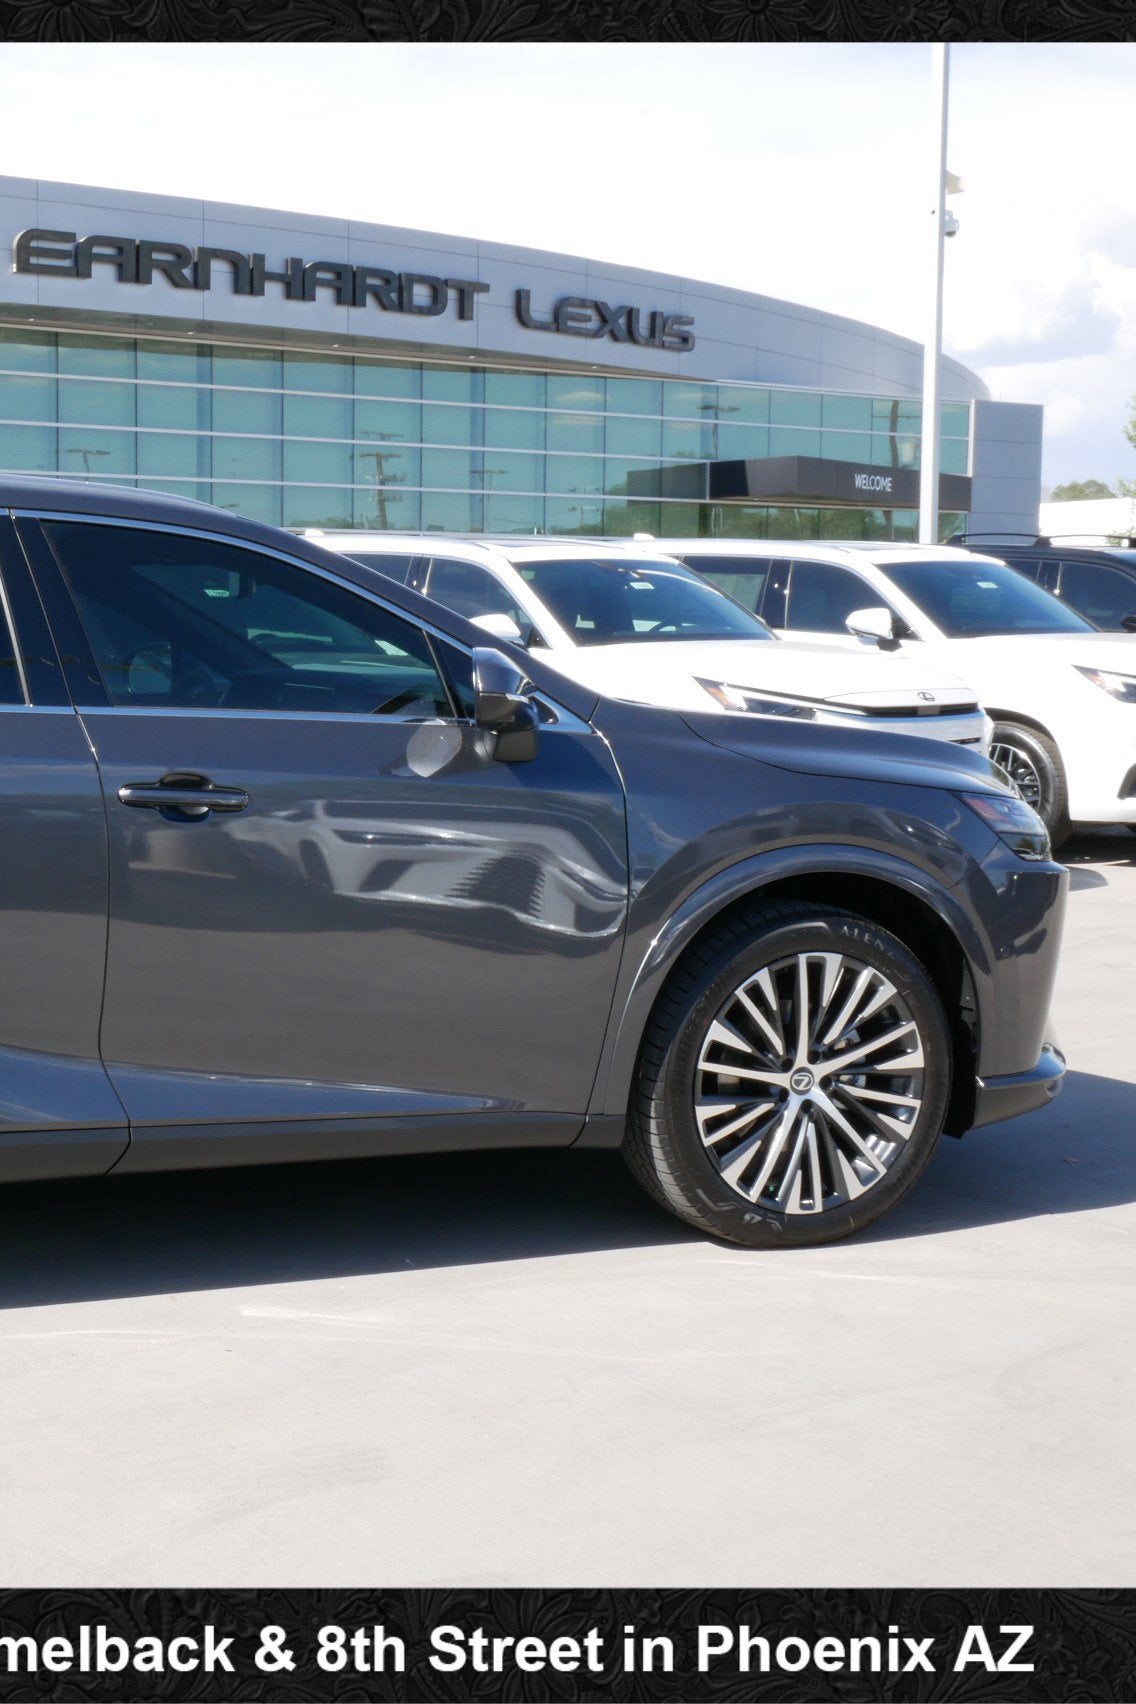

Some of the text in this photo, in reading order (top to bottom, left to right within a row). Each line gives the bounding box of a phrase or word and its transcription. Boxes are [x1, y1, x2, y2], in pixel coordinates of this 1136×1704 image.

[13, 228, 696, 352] EARNHARDT LEXUS
[854, 473, 893, 493] WELCOME
